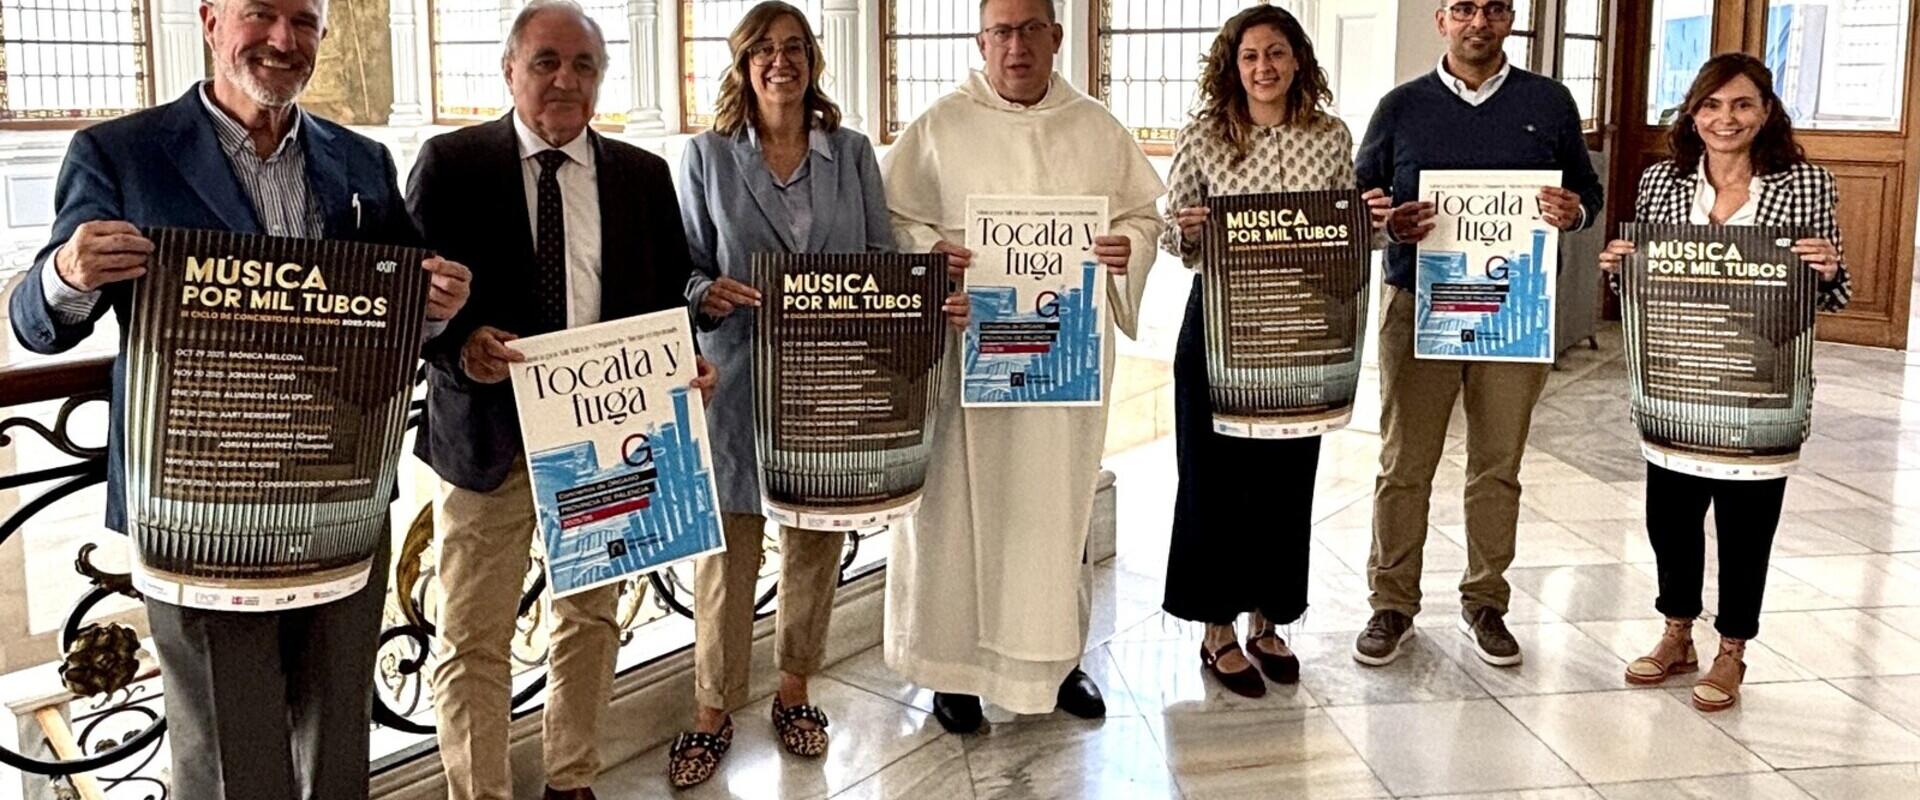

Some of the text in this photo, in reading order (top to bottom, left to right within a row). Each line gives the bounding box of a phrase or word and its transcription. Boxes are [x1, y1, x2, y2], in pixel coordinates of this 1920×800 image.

[1430, 191, 1522, 216] Tocata
[1227, 208, 1309, 229] MÚSICA
[1456, 216, 1511, 246] fuga
[977, 217, 1098, 251] Tocata y
[1228, 225, 1348, 243] POR MIL TUBOS
[1648, 239, 1742, 261] MÚSICA
[185, 256, 326, 290] MÚSICA
[1006, 247, 1063, 280] fuga
[1486, 256, 1509, 281] G
[1648, 260, 1787, 278] POR MIL TUBOS
[783, 271, 880, 294] MÚSICA
[182, 285, 388, 317] POR MIL TUBOS
[783, 294, 922, 310] POR MIL TUBOS
[1036, 290, 1060, 319] G
[176, 349, 194, 359] OCT
[228, 351, 263, 361] MÓNICA
[174, 369, 194, 378] NOV
[526, 346, 653, 399] Tocata
[663, 341, 681, 377] y
[572, 385, 648, 427] fuga
[622, 433, 654, 468] G
